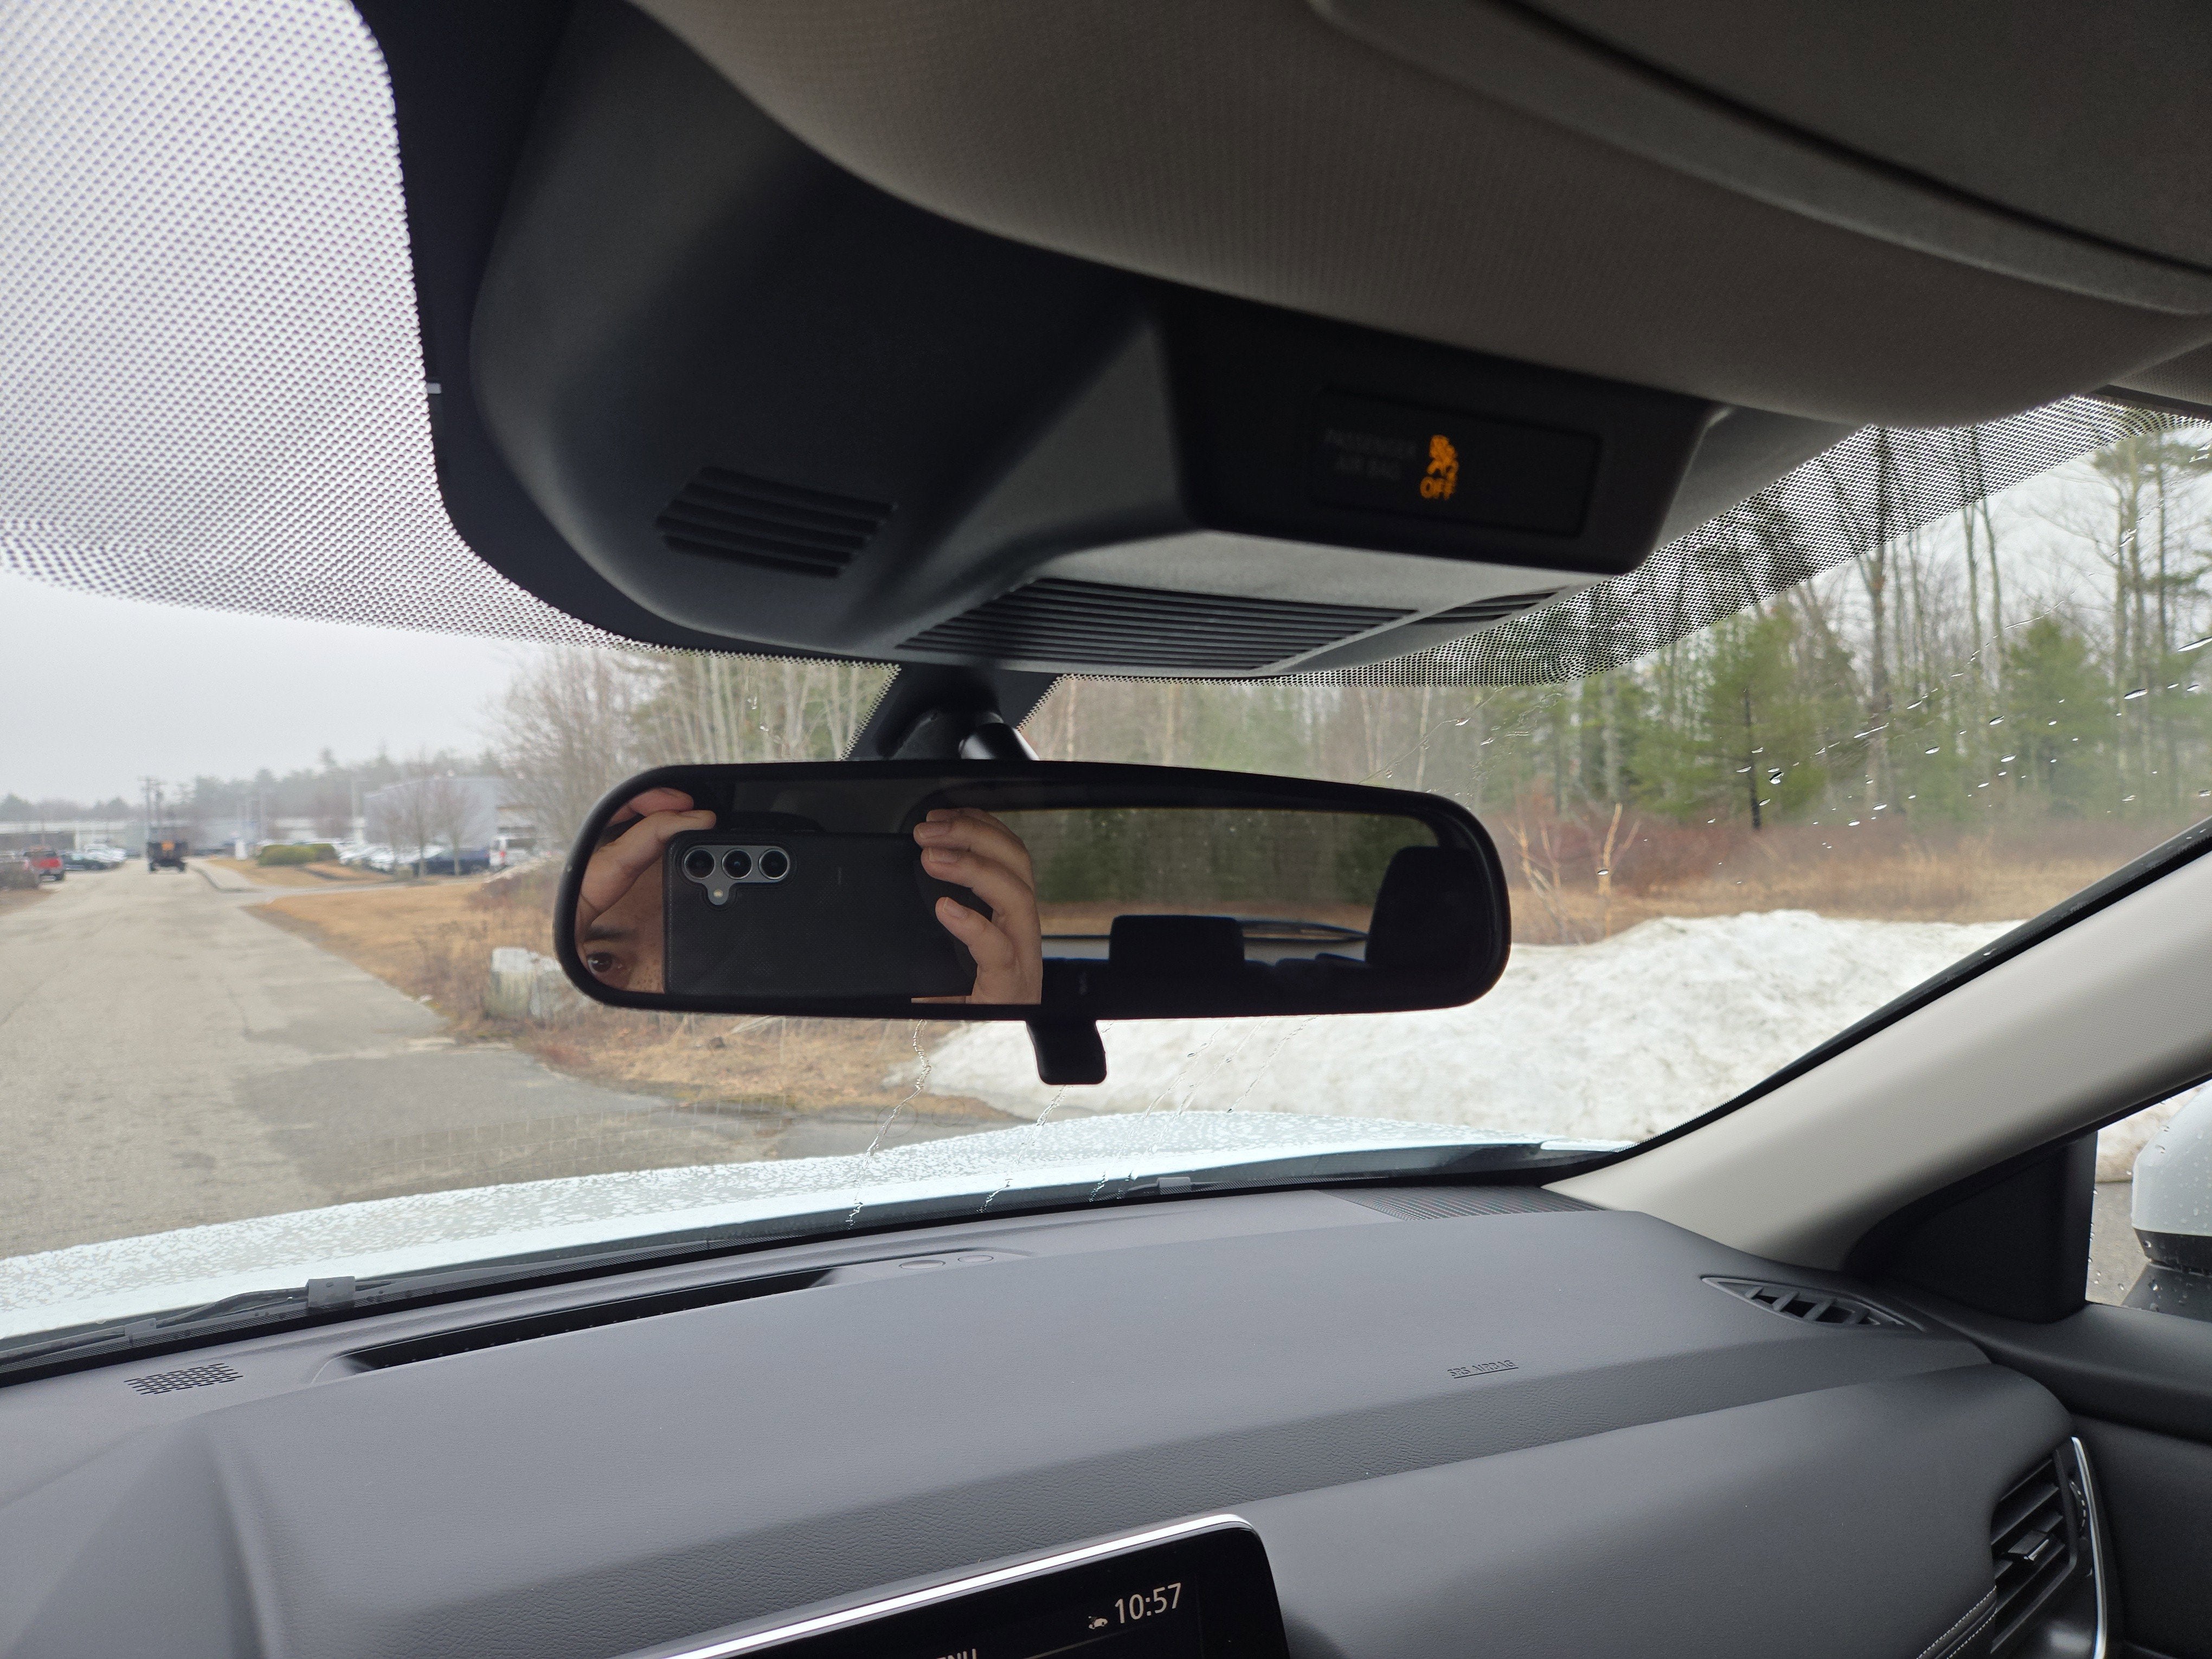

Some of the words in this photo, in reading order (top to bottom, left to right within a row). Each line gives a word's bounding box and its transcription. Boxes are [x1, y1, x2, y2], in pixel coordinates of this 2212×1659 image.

[1447, 1367, 1471, 1376] SRS
[1472, 1360, 1515, 1372] AIRBAG
[1115, 1582, 1181, 1624] 10:57
